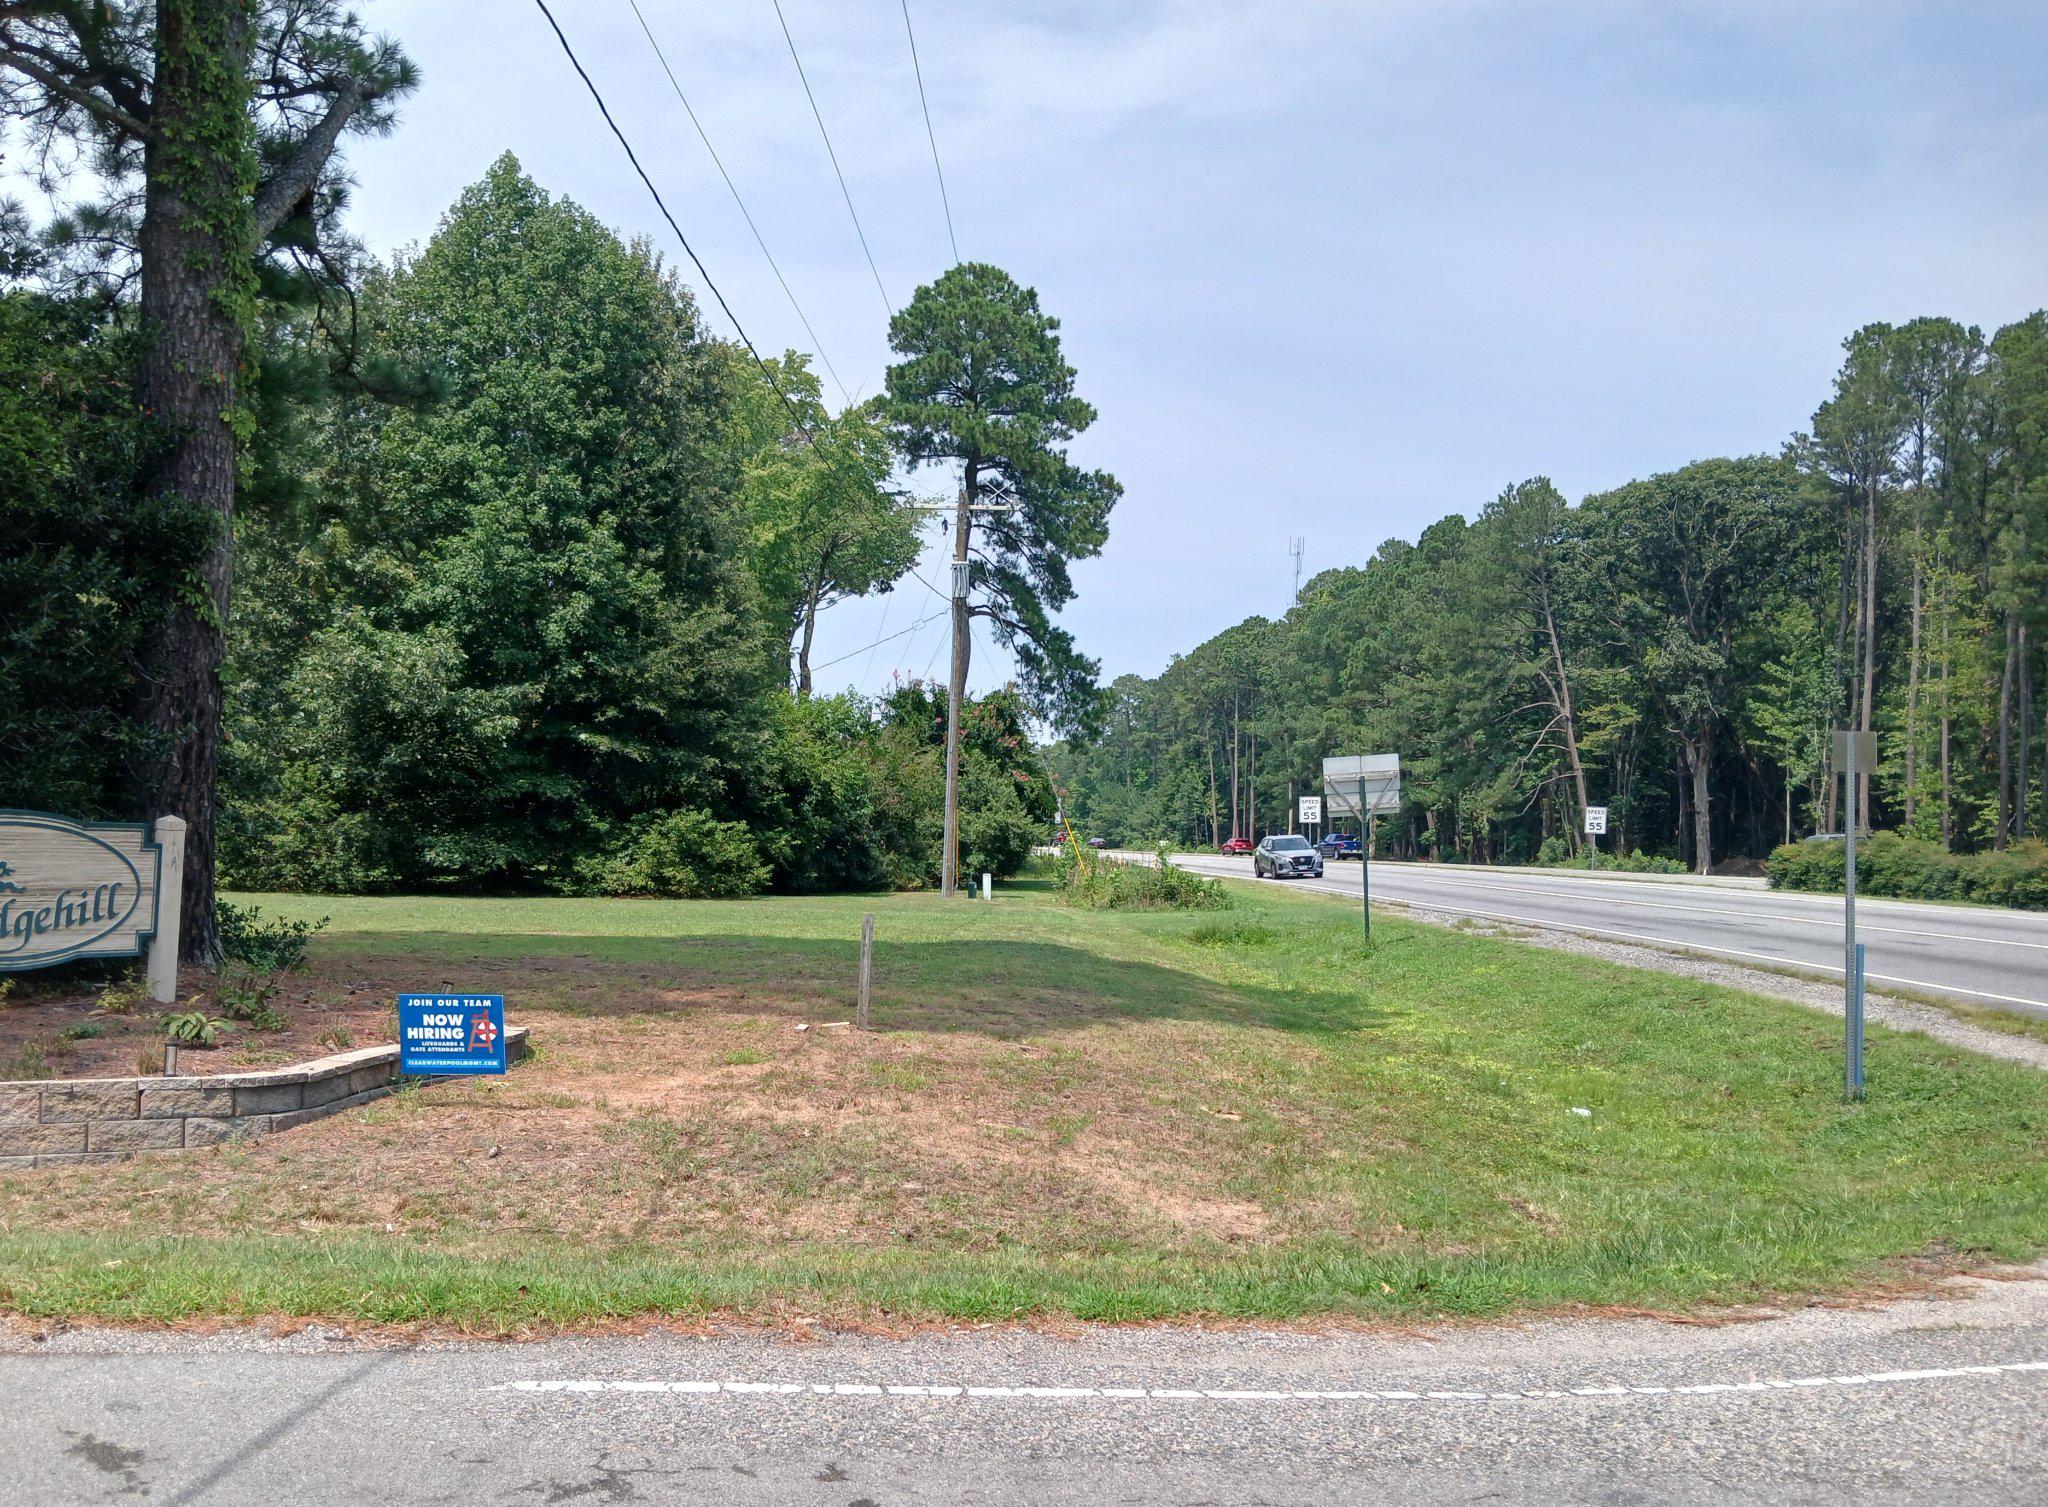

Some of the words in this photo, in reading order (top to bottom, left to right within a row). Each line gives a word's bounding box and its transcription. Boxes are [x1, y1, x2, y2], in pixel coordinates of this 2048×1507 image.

[1303, 811, 1317, 820] 55
[1588, 822, 1603, 831] 55
[408, 998, 432, 1007] JOIN
[437, 998, 459, 1007] OUR
[463, 999, 492, 1007] TEAM
[422, 1013, 464, 1026] NOW
[407, 1026, 465, 1040] HIRING
